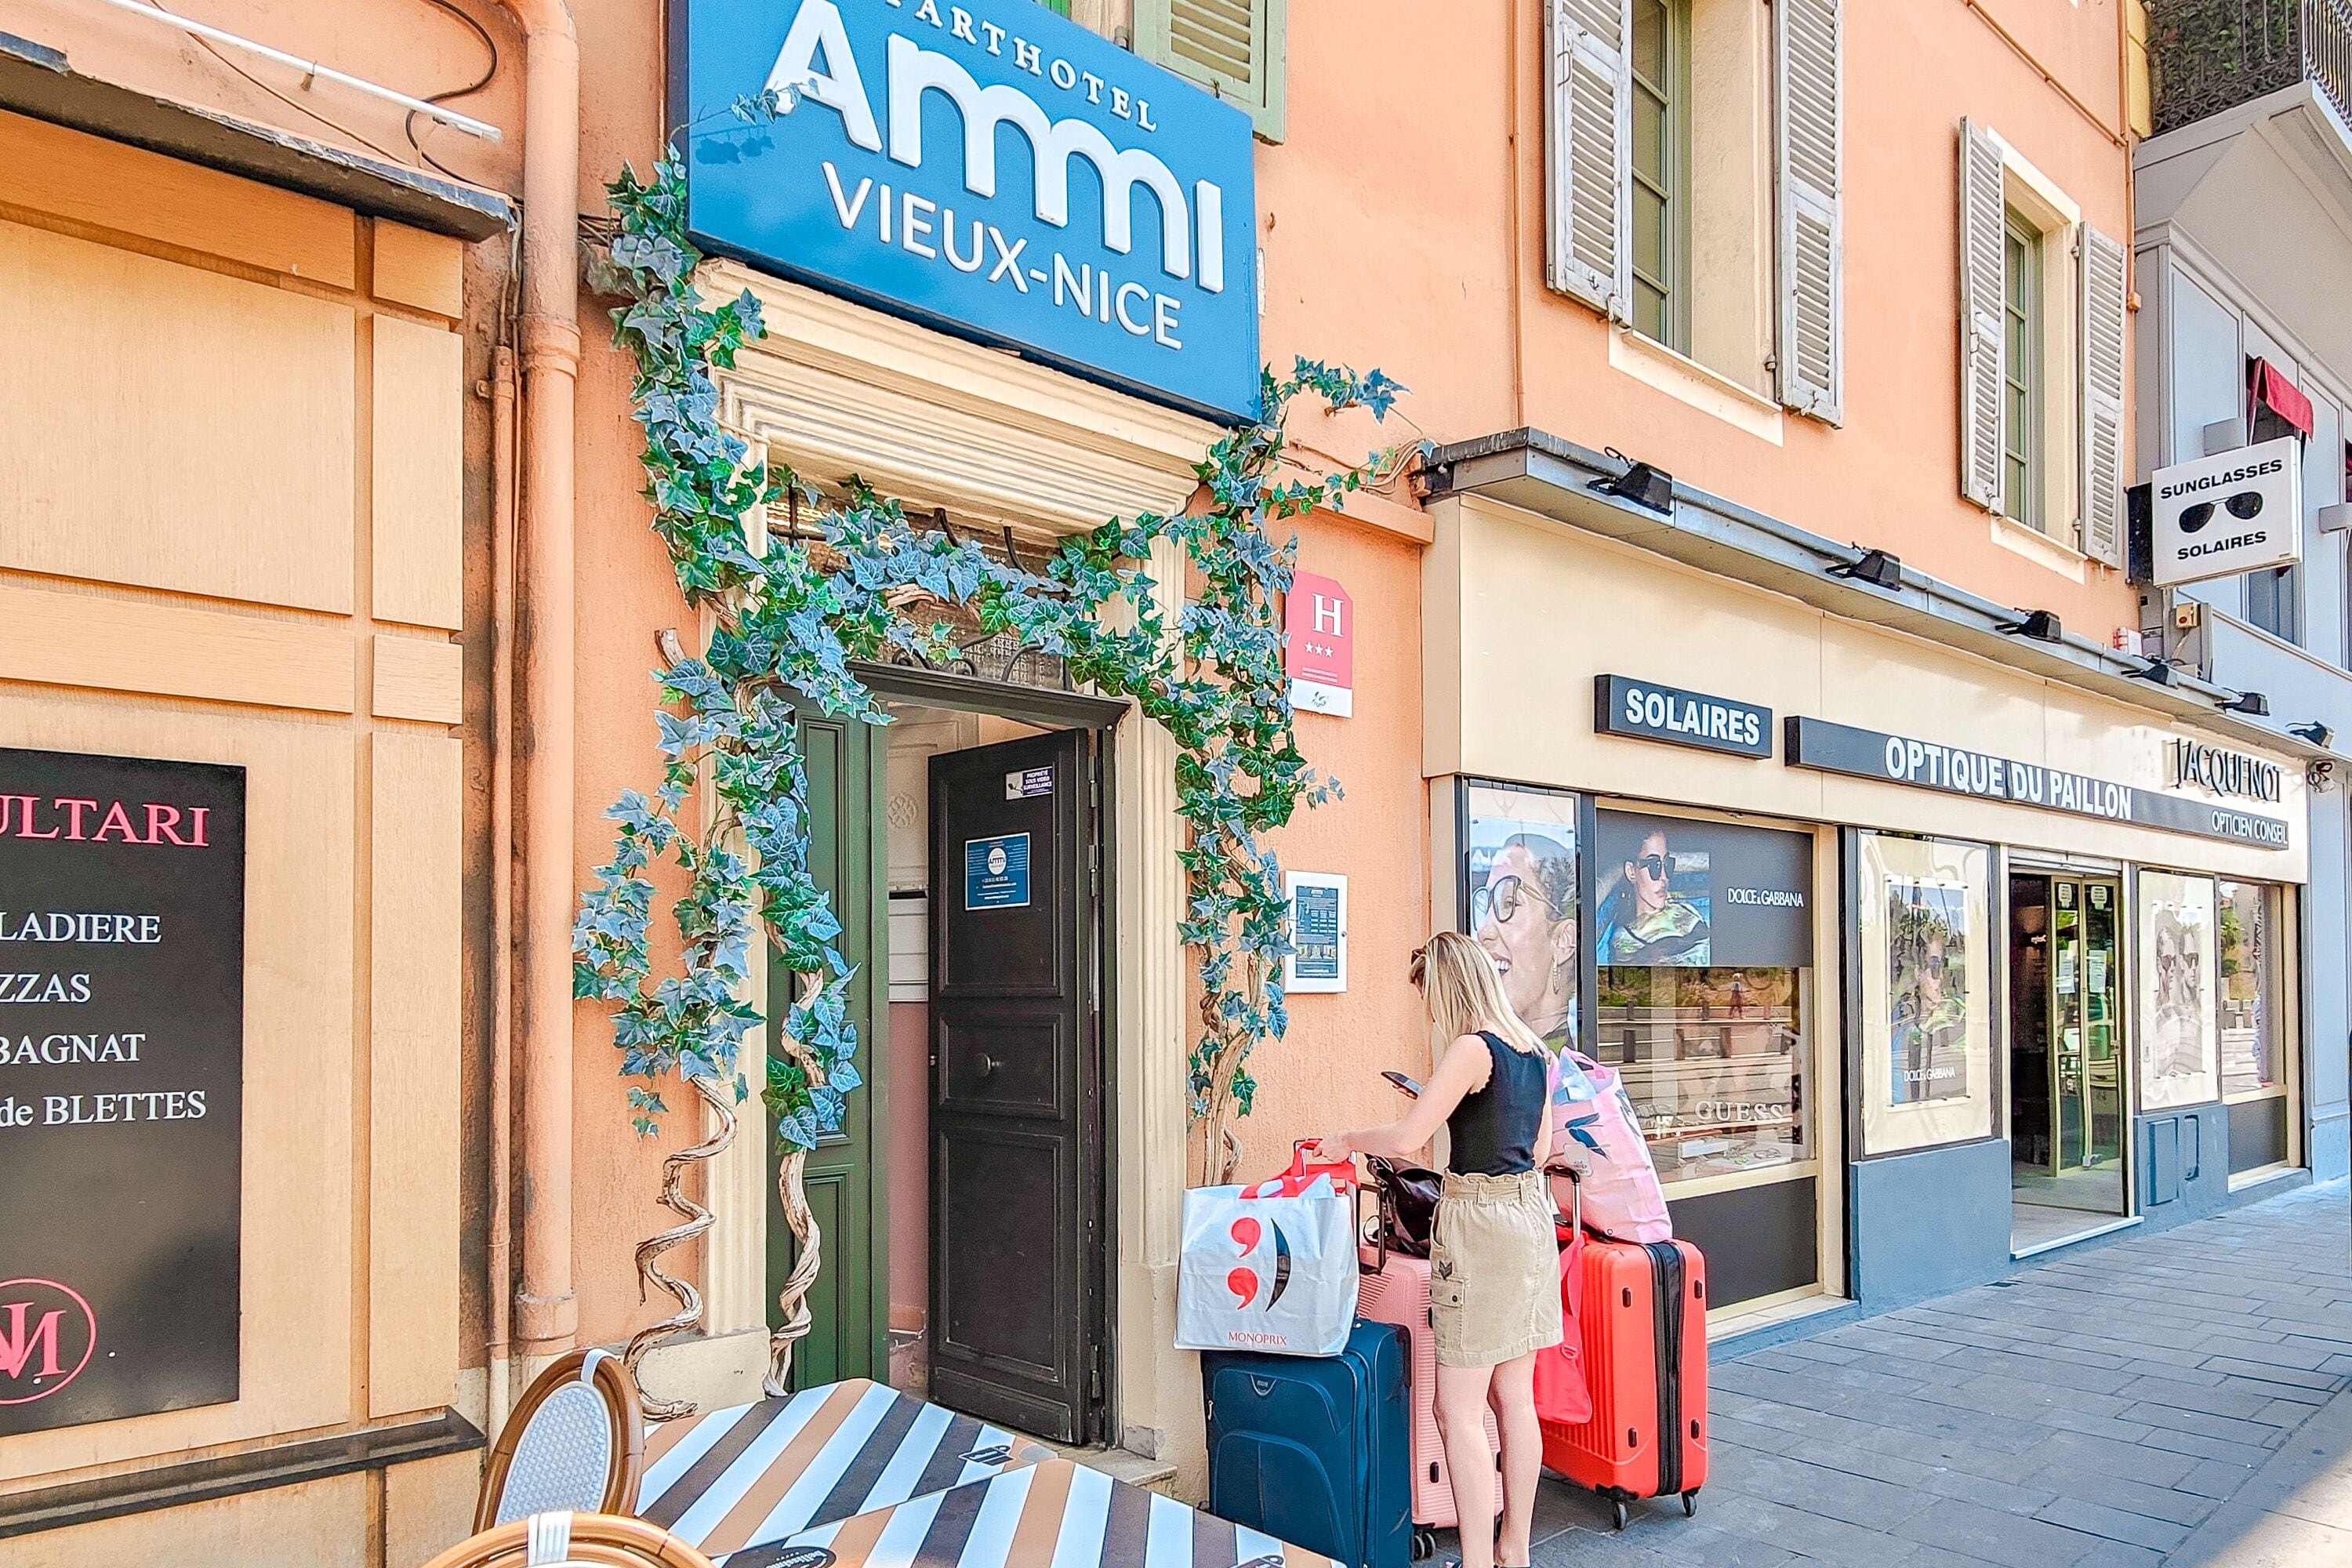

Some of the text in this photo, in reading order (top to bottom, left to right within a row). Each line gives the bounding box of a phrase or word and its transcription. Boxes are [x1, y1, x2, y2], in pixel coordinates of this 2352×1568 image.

[887, 0, 1158, 132] ARTHOTEL
[821, 160, 1183, 350] VIEUX-NICE
[2160, 459, 2283, 499] SUNGLASSES
[2176, 531, 2267, 560] SOLAIRES
[1312, 593, 1345, 637] H
[1625, 688, 1760, 746] SOLAIRES
[1884, 735, 2133, 821] OPTIQUE DU PAILLON
[2211, 810, 2288, 845] OPTICIEN CONSEIL
[42, 1091, 207, 1125] BLETTES
[1694, 1100, 1784, 1121] GUESS
[1228, 1331, 1288, 1346] MONOPRIX
